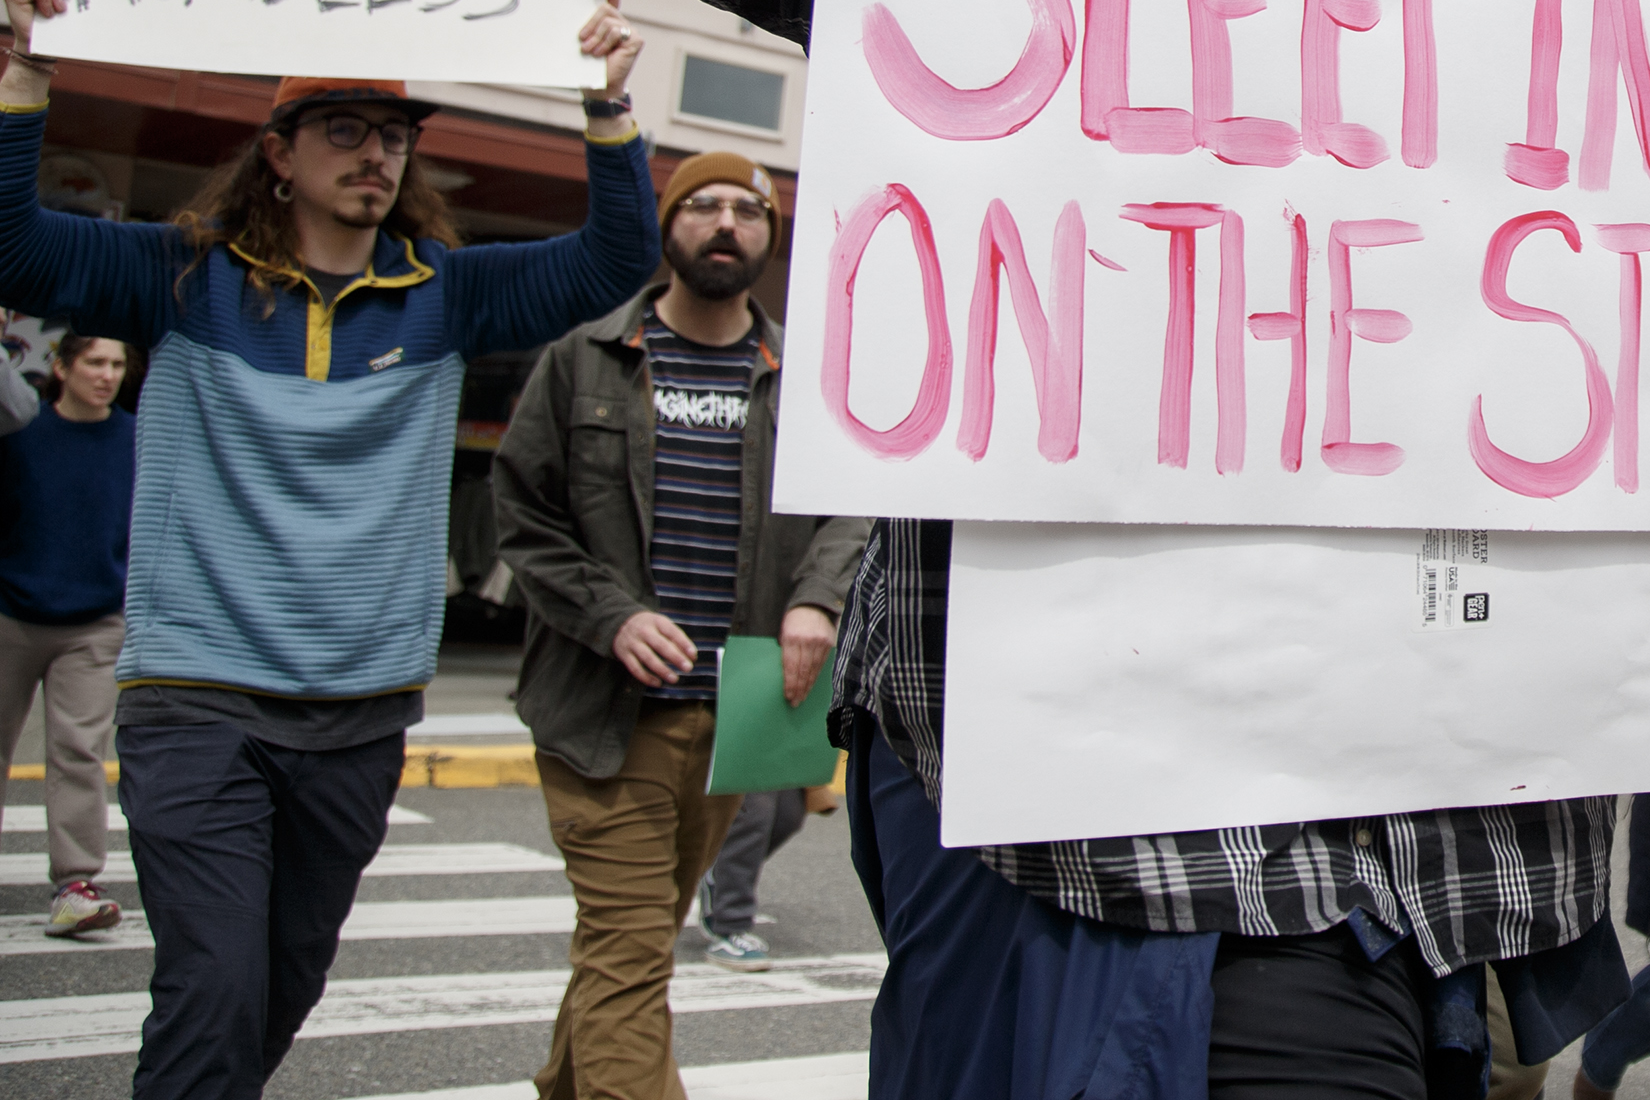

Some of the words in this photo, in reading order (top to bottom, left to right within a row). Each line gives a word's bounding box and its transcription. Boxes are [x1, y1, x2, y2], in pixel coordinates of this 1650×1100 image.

[823, 183, 1087, 464] ON
[1120, 200, 1425, 477] THE
[1467, 598, 1478, 619] GEAR
